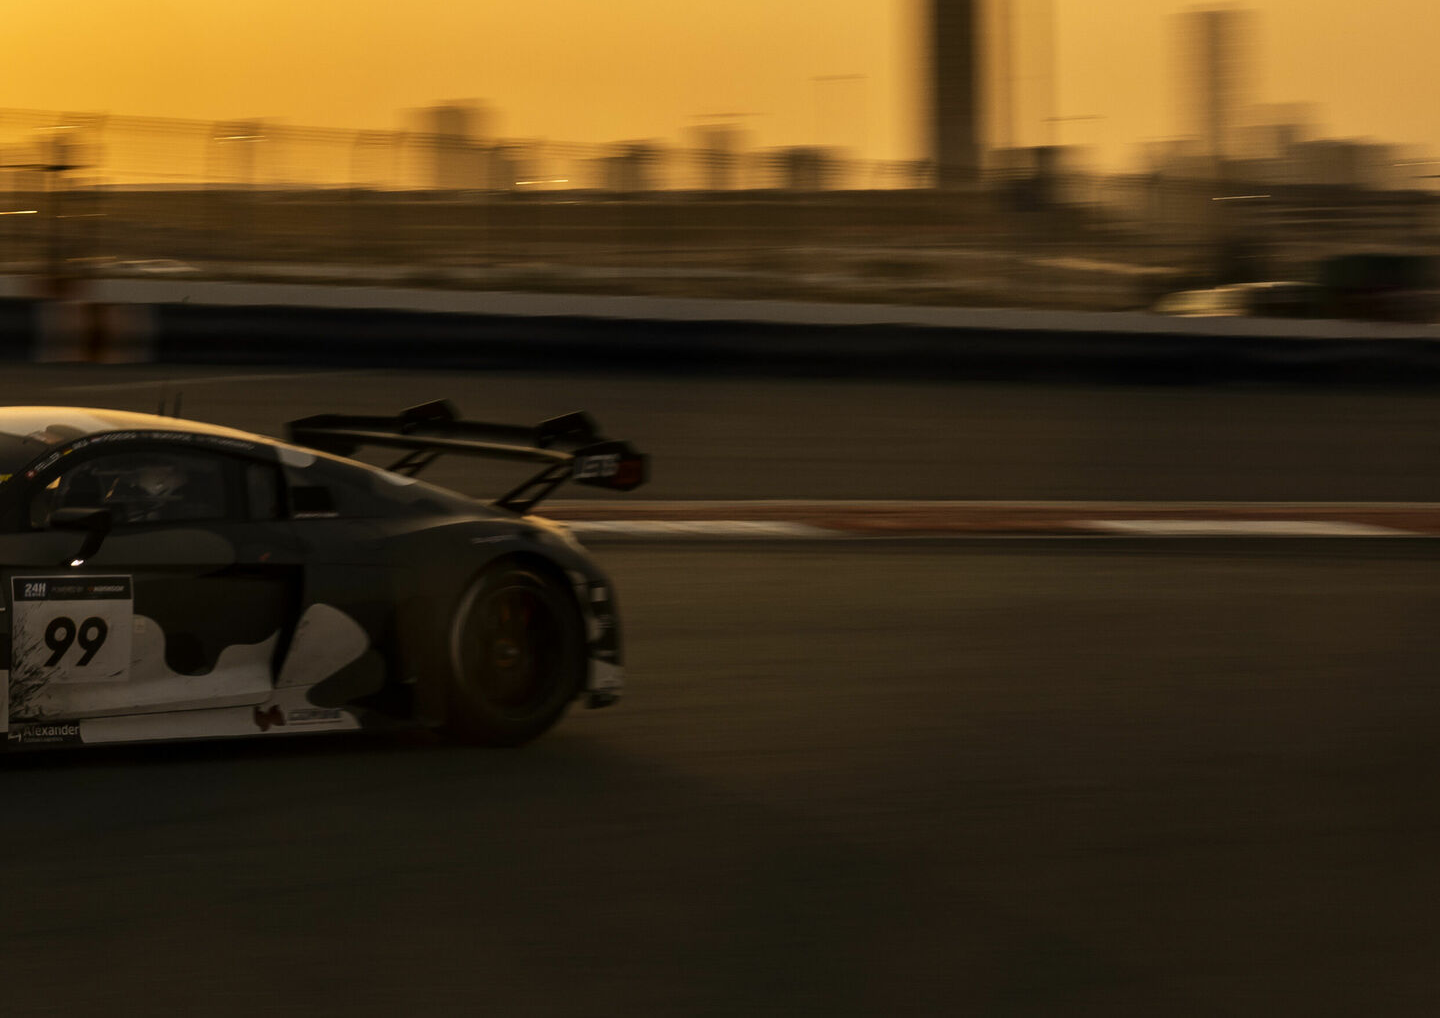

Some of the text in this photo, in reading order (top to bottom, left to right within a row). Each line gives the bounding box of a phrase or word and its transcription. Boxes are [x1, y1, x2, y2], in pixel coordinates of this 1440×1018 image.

[24, 582, 46, 593] 24H
[44, 616, 108, 667] 99
[23, 724, 80, 737] Alexander
